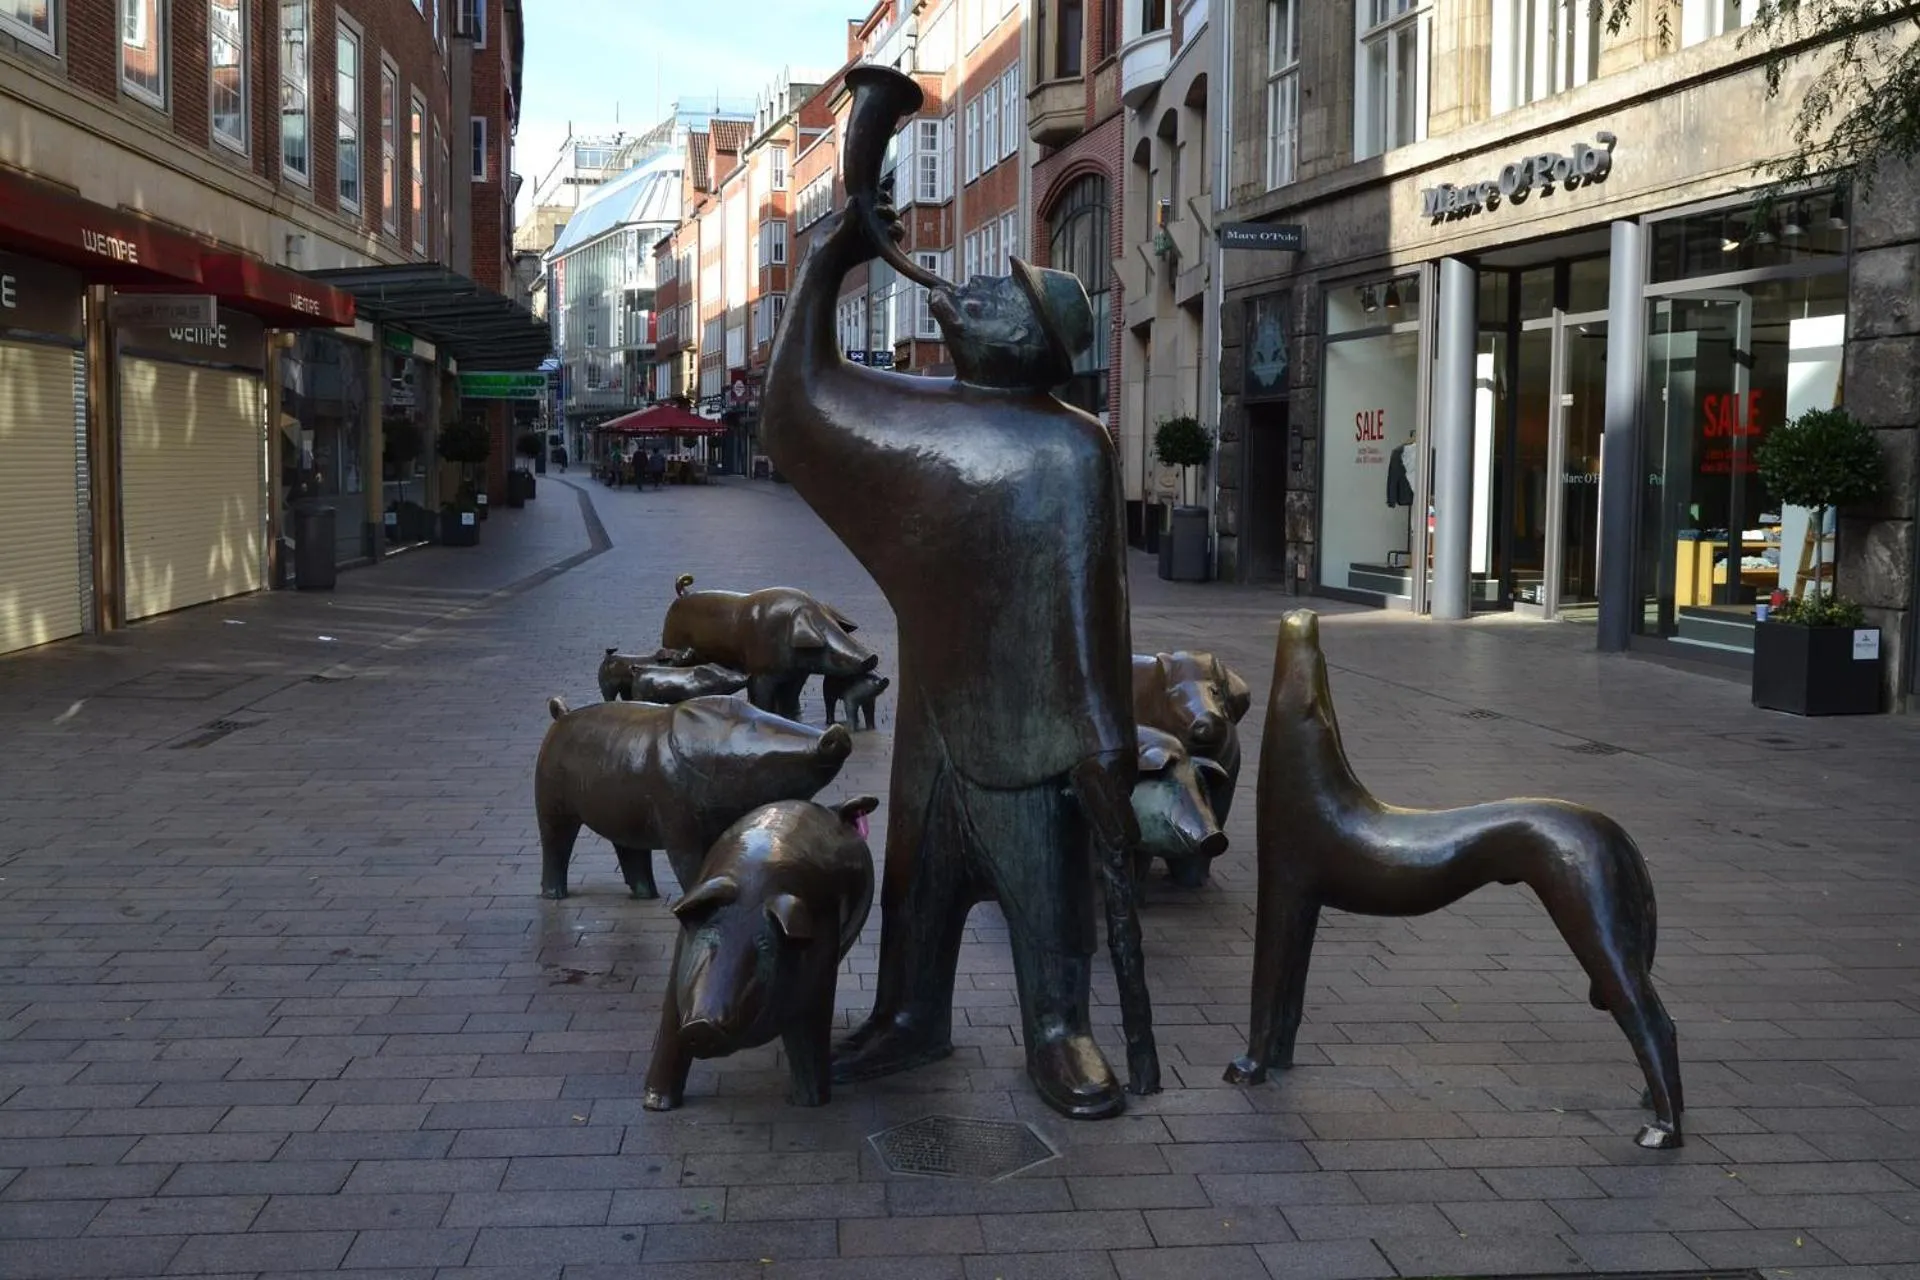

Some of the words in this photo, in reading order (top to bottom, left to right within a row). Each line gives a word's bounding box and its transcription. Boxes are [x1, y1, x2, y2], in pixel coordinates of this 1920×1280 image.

[1420, 179, 1500, 218] Marc
[81, 228, 138, 264] WEMPE
[1227, 231, 1257, 240] Marc
[1260, 232, 1299, 241] O'Polo
[289, 291, 321, 316] WEMPE
[1355, 409, 1384, 442] SALE
[1703, 389, 1763, 437] SALE
[1561, 473, 1583, 484] Marc
